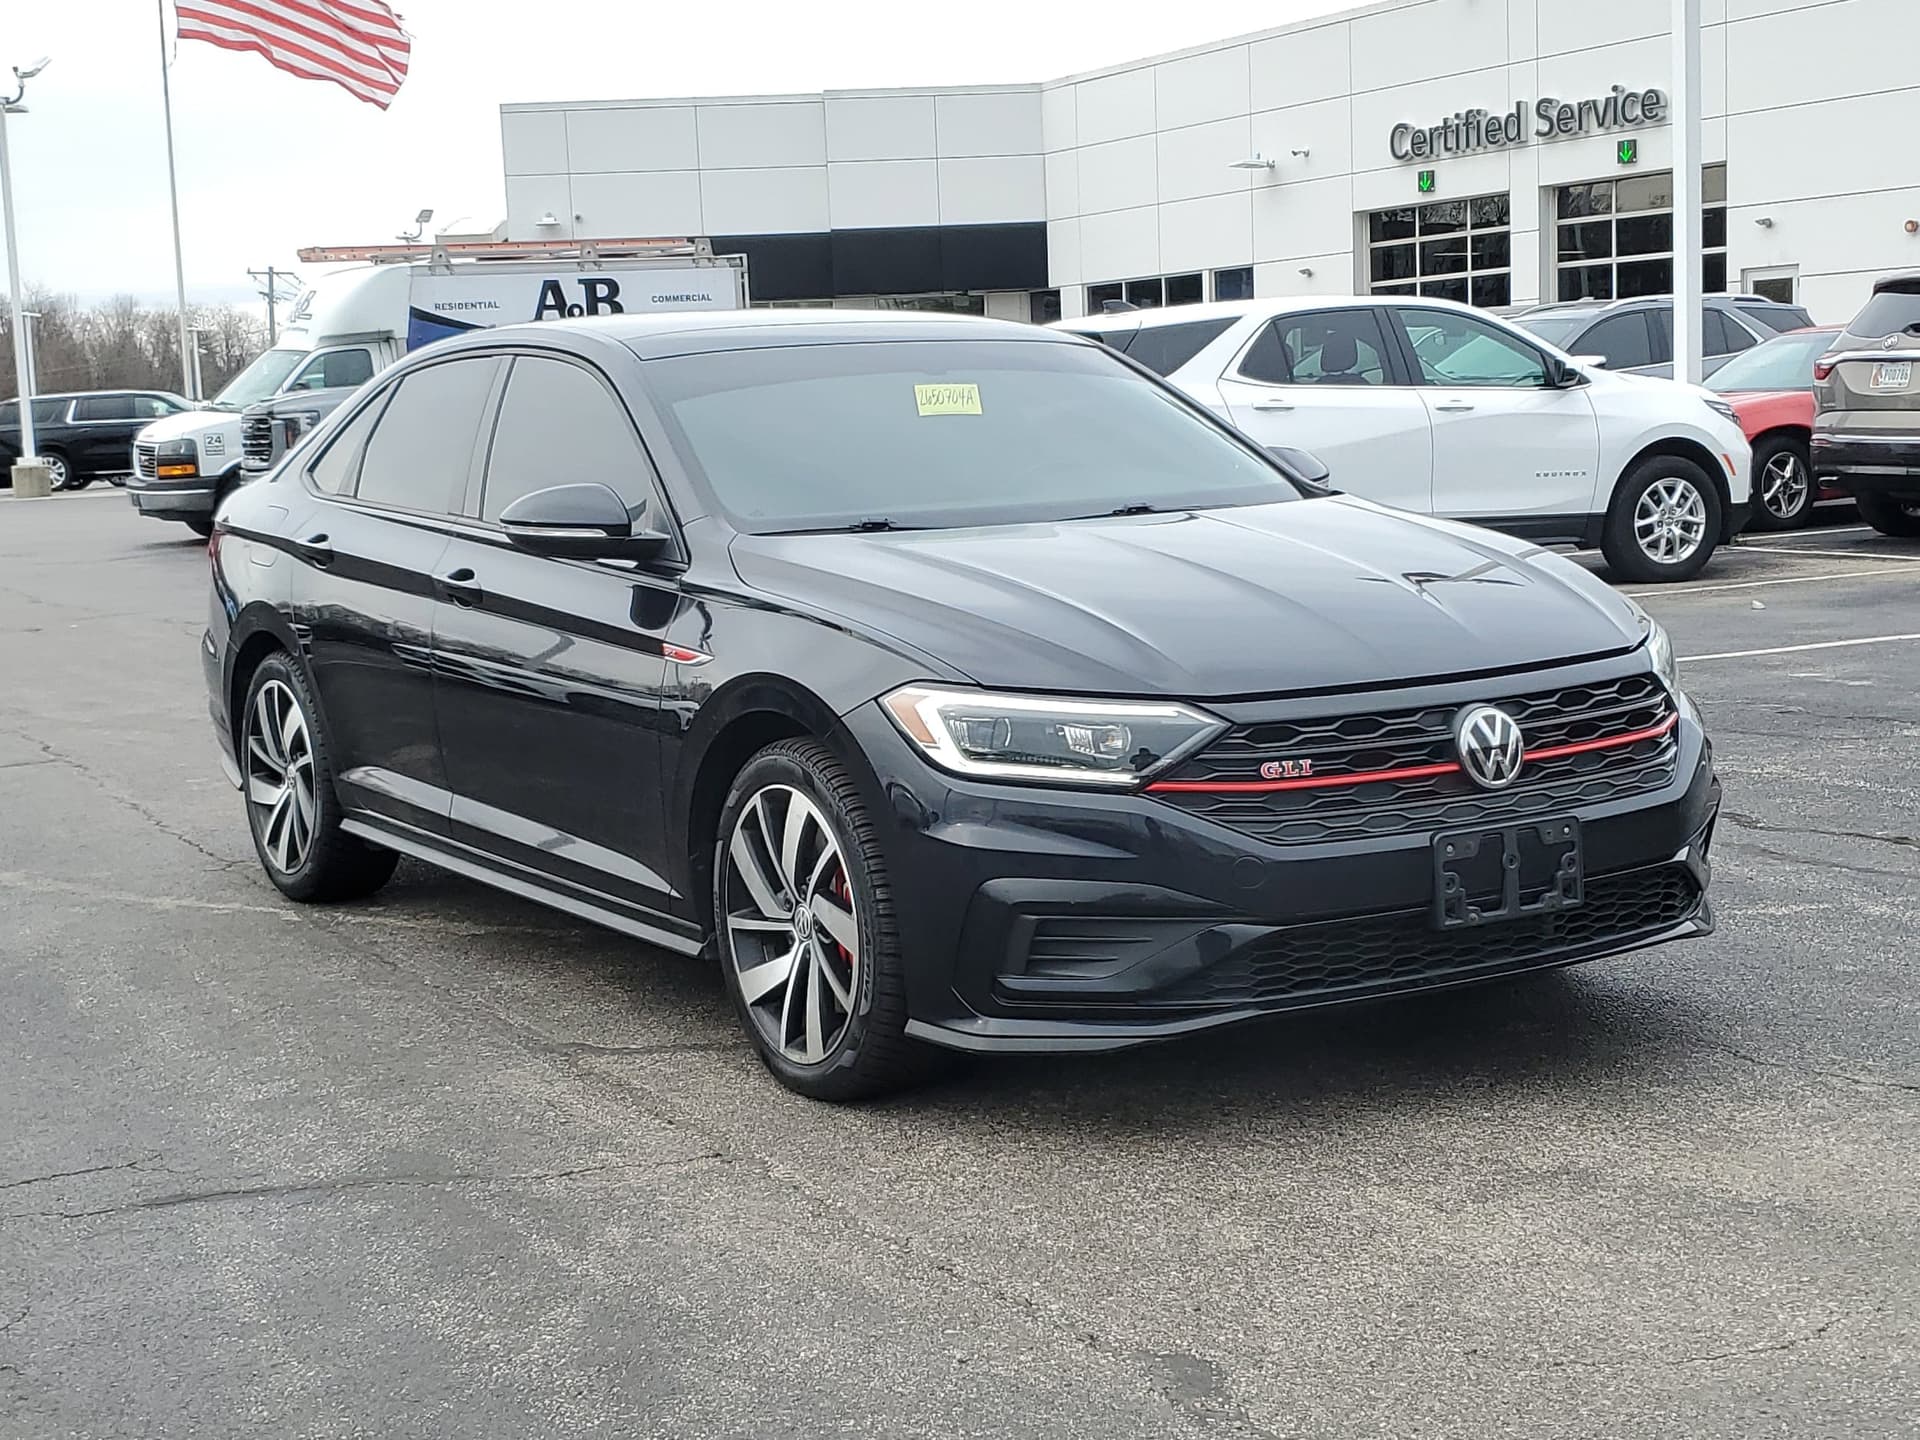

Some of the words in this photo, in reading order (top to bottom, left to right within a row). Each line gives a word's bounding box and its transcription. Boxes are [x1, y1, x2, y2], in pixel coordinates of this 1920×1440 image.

[1390, 101, 1524, 160] Certified
[1535, 85, 1664, 138] Service
[651, 294, 712, 303] COMMERCIAL
[434, 301, 500, 311] RESIDENTIAL
[206, 435, 222, 445] 24
[1260, 759, 1312, 779] GLI
